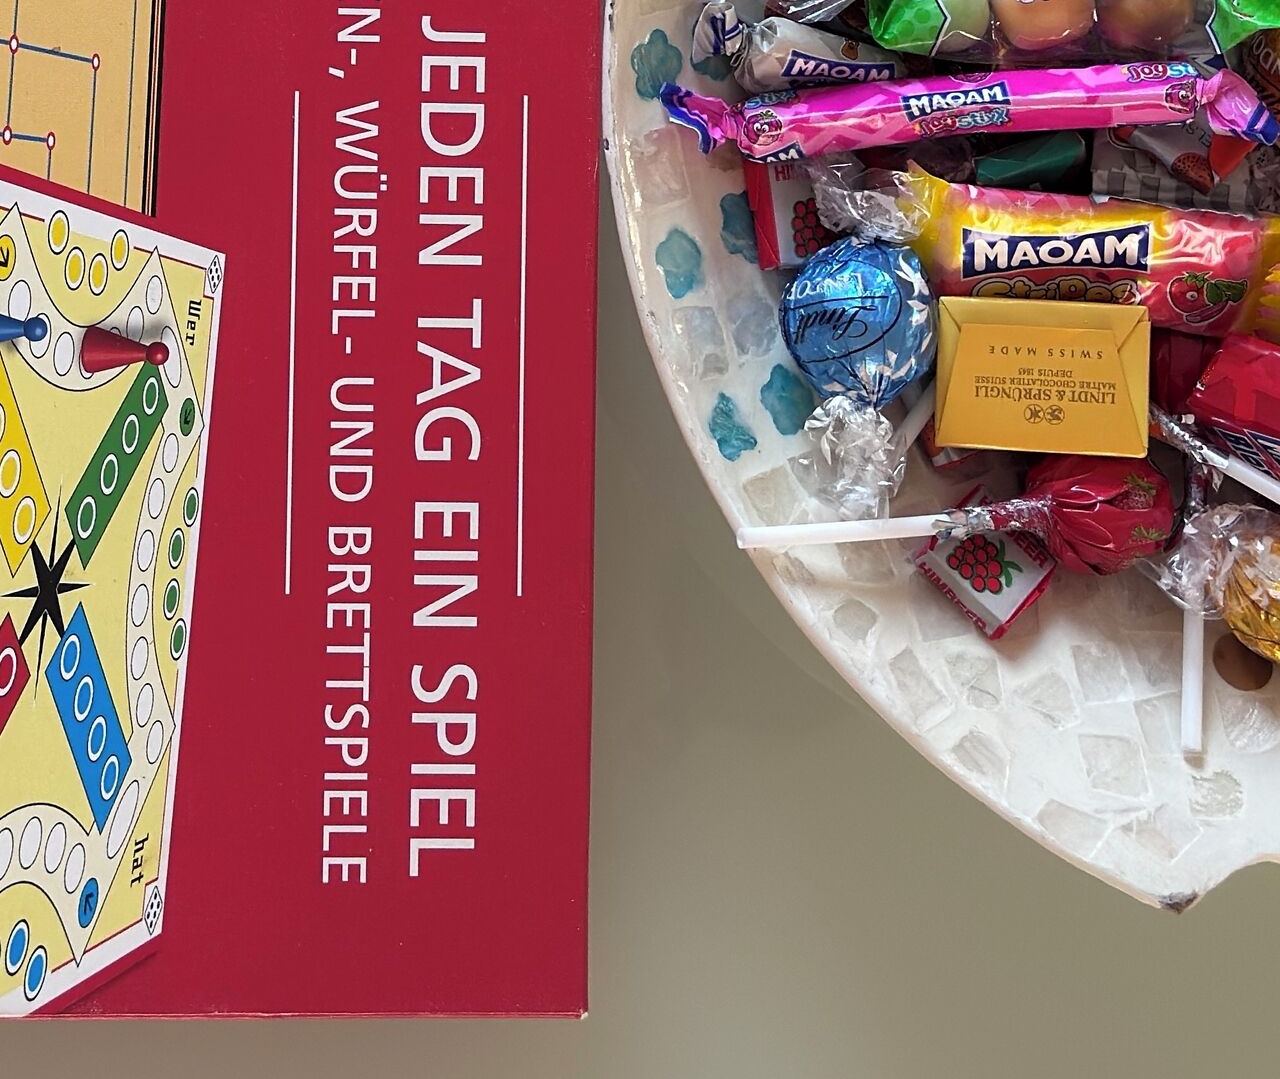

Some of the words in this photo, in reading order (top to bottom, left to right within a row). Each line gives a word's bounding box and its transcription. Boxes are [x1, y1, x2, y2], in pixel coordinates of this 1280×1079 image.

[790, 58, 890, 81] MAOAM
[910, 86, 1004, 117] MAOAM
[418, 15, 487, 267] JEDEN
[331, 100, 388, 355] WÜRFEL-
[974, 232, 1140, 272] MAOAM
[185, 298, 202, 346] Wer
[989, 345, 1037, 356] MADE
[1047, 348, 1103, 360] SWISS
[414, 298, 483, 462] TAG
[975, 376, 1007, 385] SUISSE
[1008, 377, 1076, 388] CHOCOLATIER
[1038, 369, 1073, 378] DEPUIS
[1079, 380, 1116, 392] MAÎTRE
[975, 385, 1051, 402] SPRÜNGLI
[1054, 390, 1066, 401] &
[1070, 391, 1116, 405] LINDT
[328, 376, 375, 503] UND
[412, 501, 480, 628] EIN
[321, 526, 372, 885] BRETTSPIELE
[409, 664, 479, 878] SPIEL
[130, 832, 149, 888] hat
